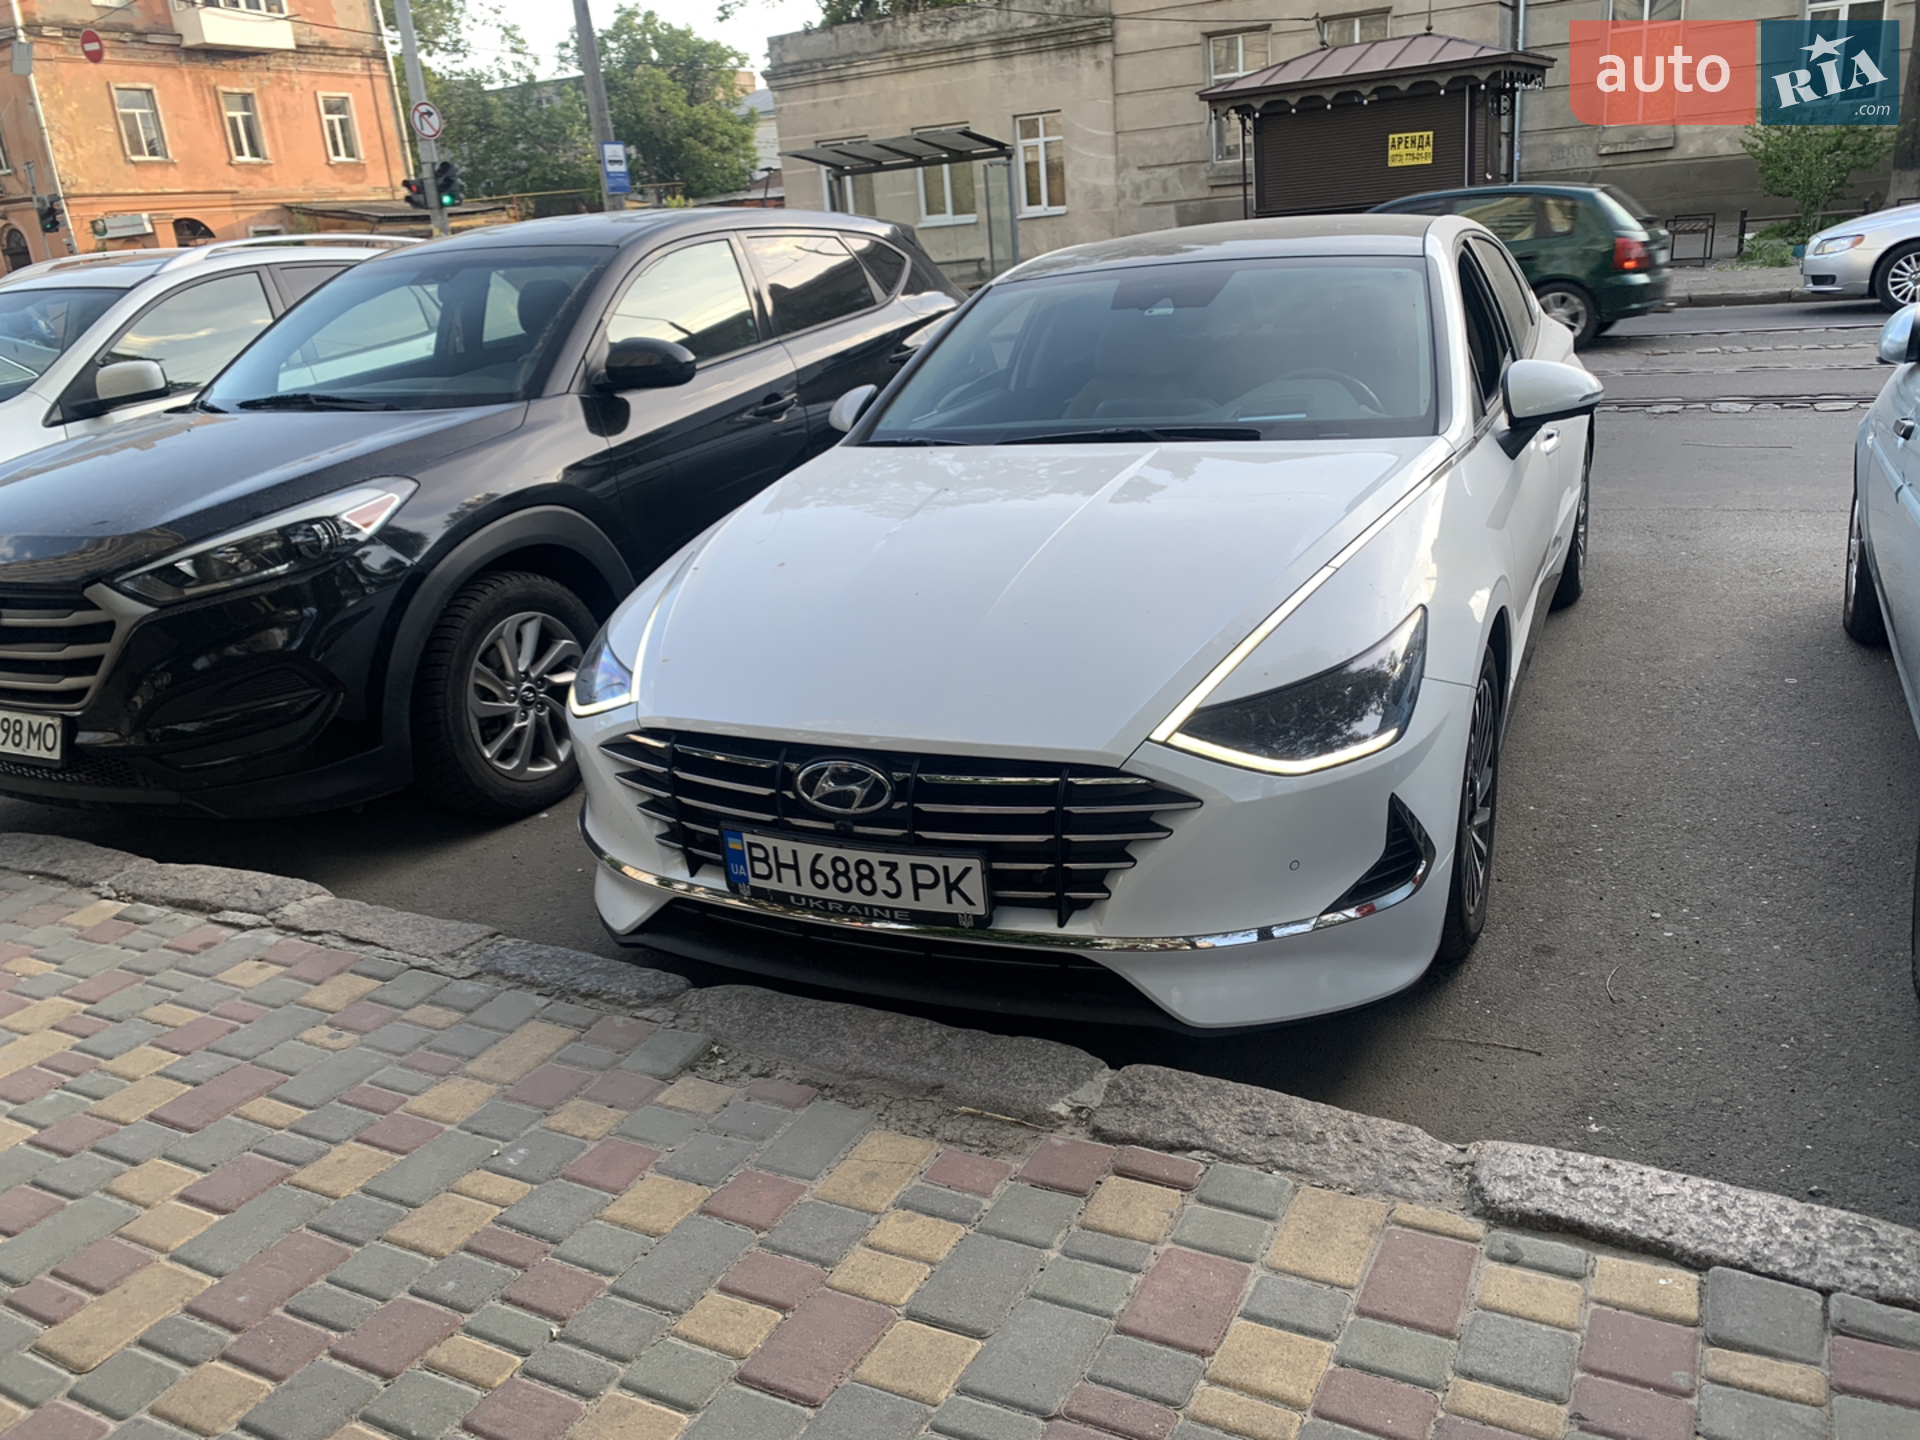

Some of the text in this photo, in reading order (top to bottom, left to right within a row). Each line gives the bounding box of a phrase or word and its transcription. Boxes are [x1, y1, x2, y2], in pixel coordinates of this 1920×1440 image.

[1390, 134, 1432, 151] АРЕНДА
[26, 720, 58, 752] MO
[730, 862, 747, 877] UA
[746, 841, 976, 906] BH 6883 PK
[789, 895, 912, 921] UKRAINE
